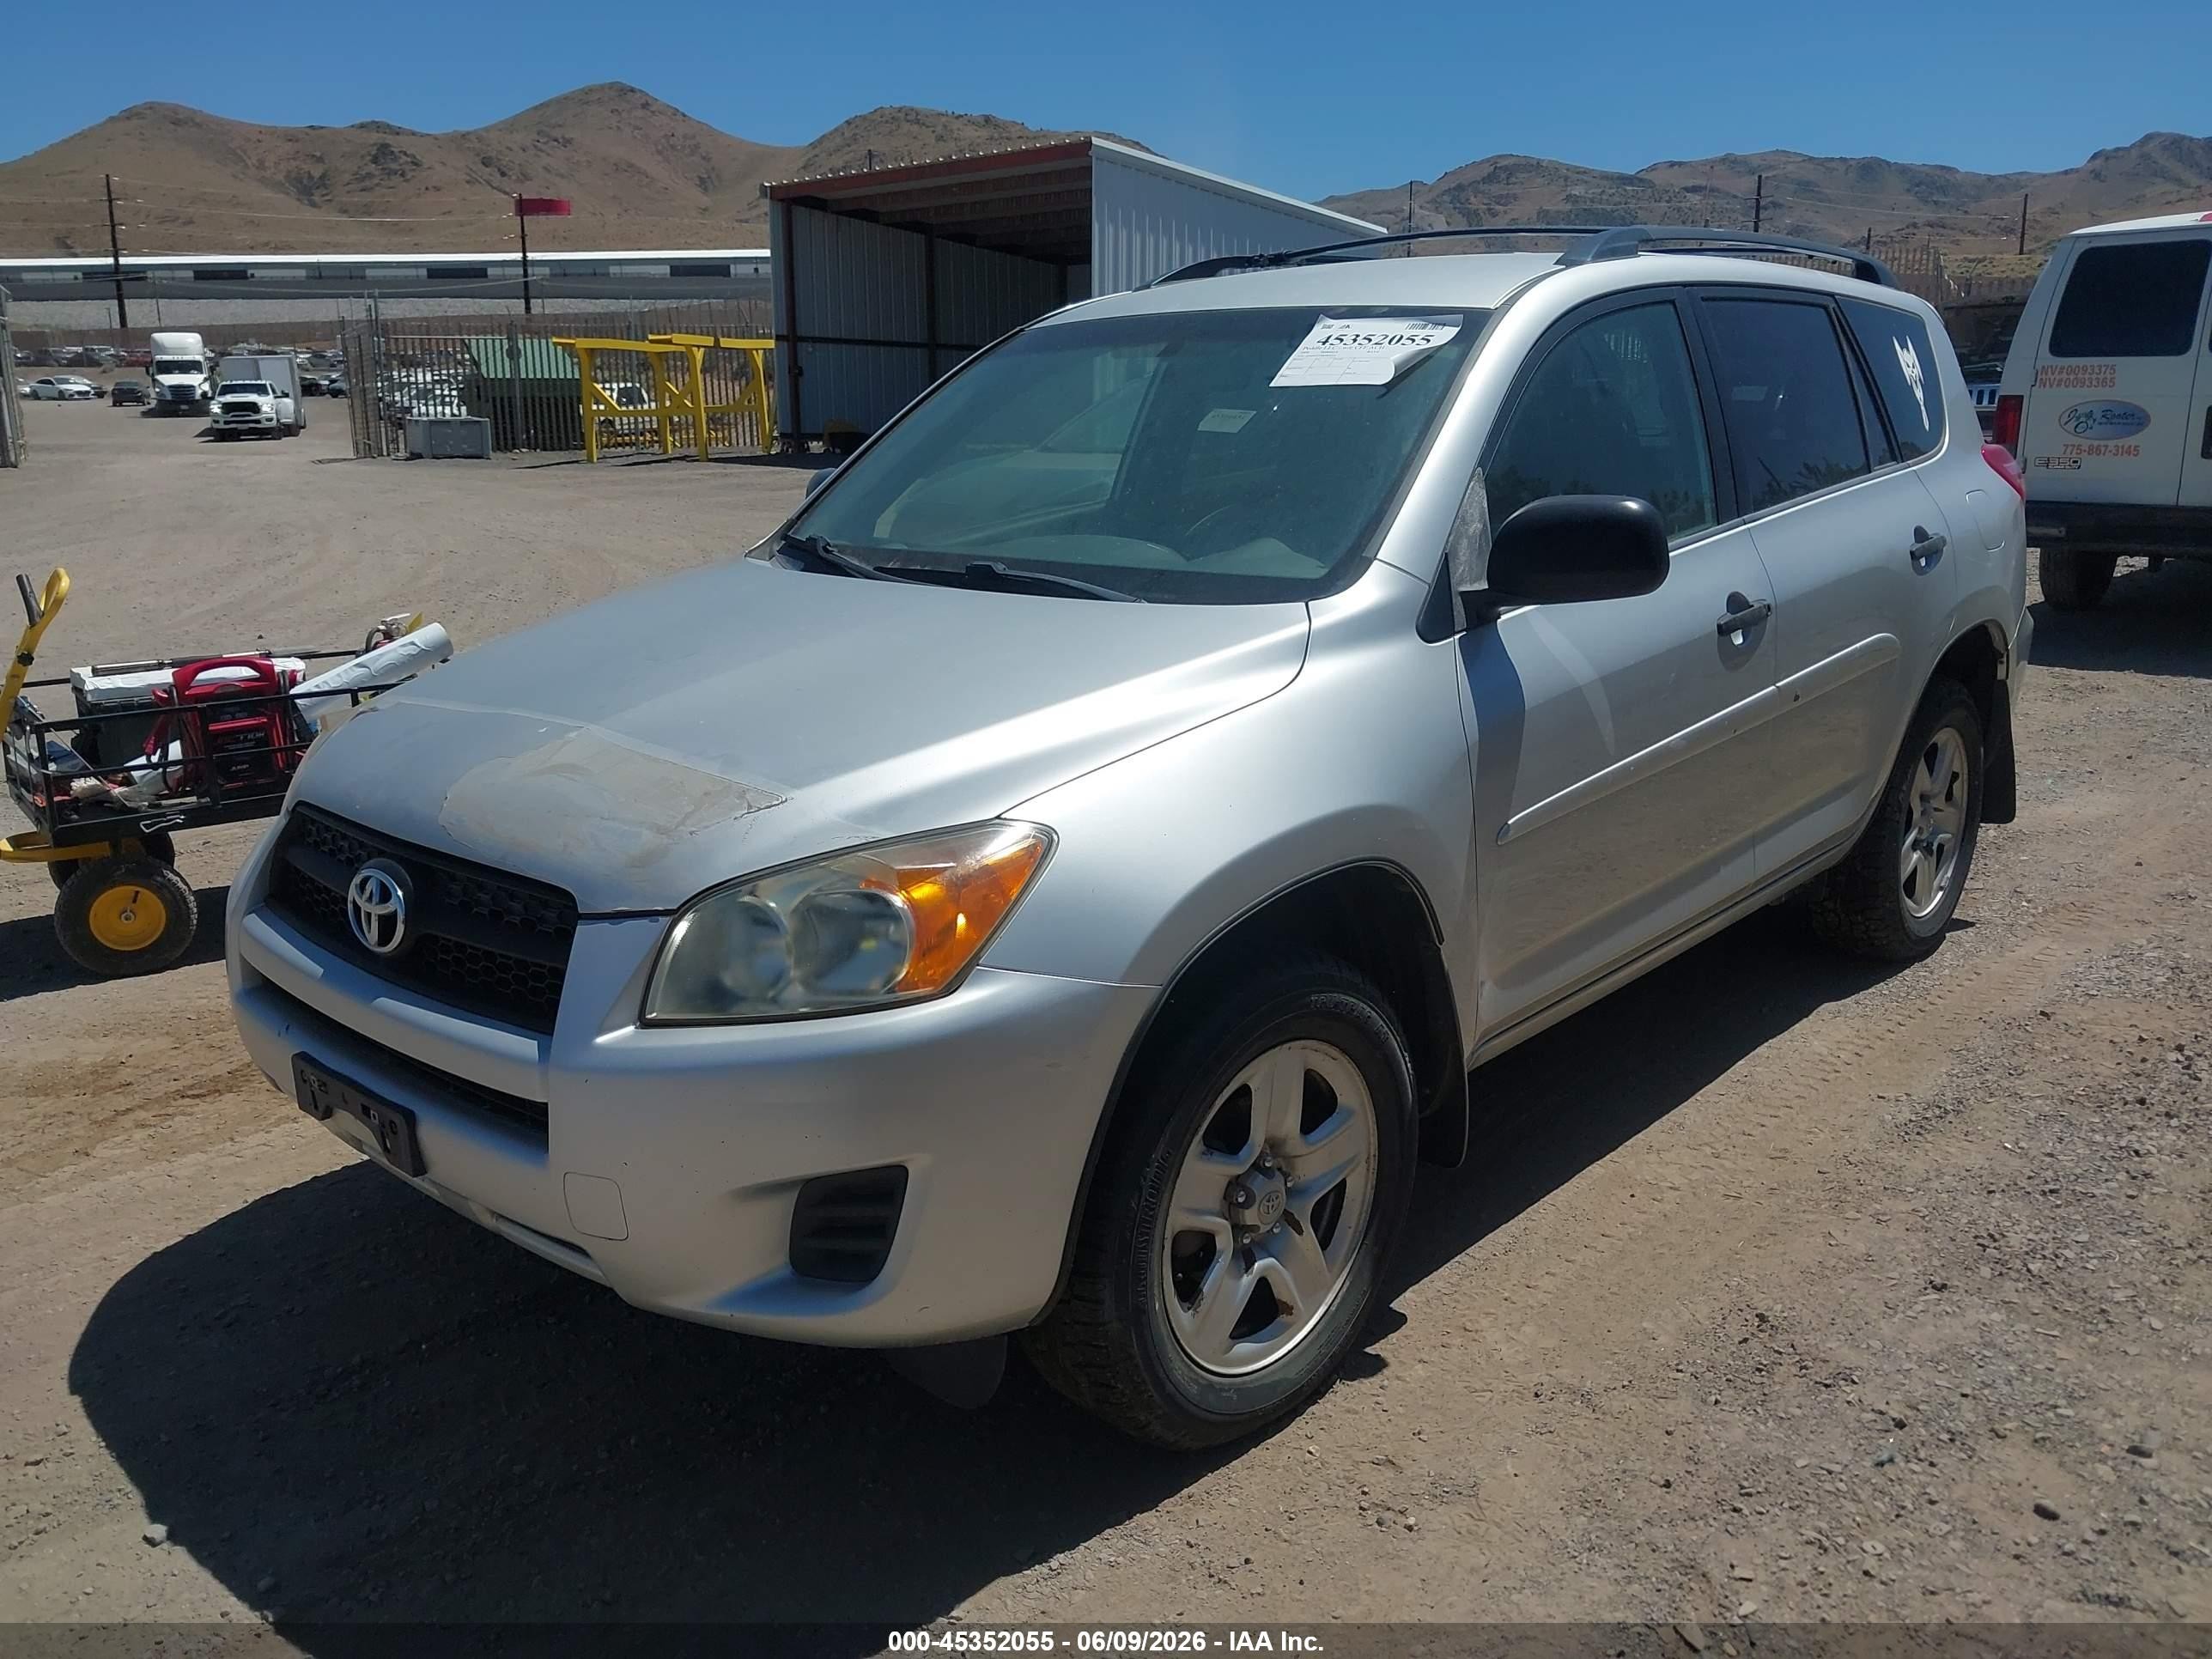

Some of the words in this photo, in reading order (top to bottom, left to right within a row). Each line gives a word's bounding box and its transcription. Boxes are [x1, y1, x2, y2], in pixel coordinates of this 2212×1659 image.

[1316, 333, 1436, 346] 45352055
[2039, 364, 2117, 376] NV#0093375
[2038, 376, 2117, 388] NV#0093365
[2062, 443, 2141, 458] 775-867-3145
